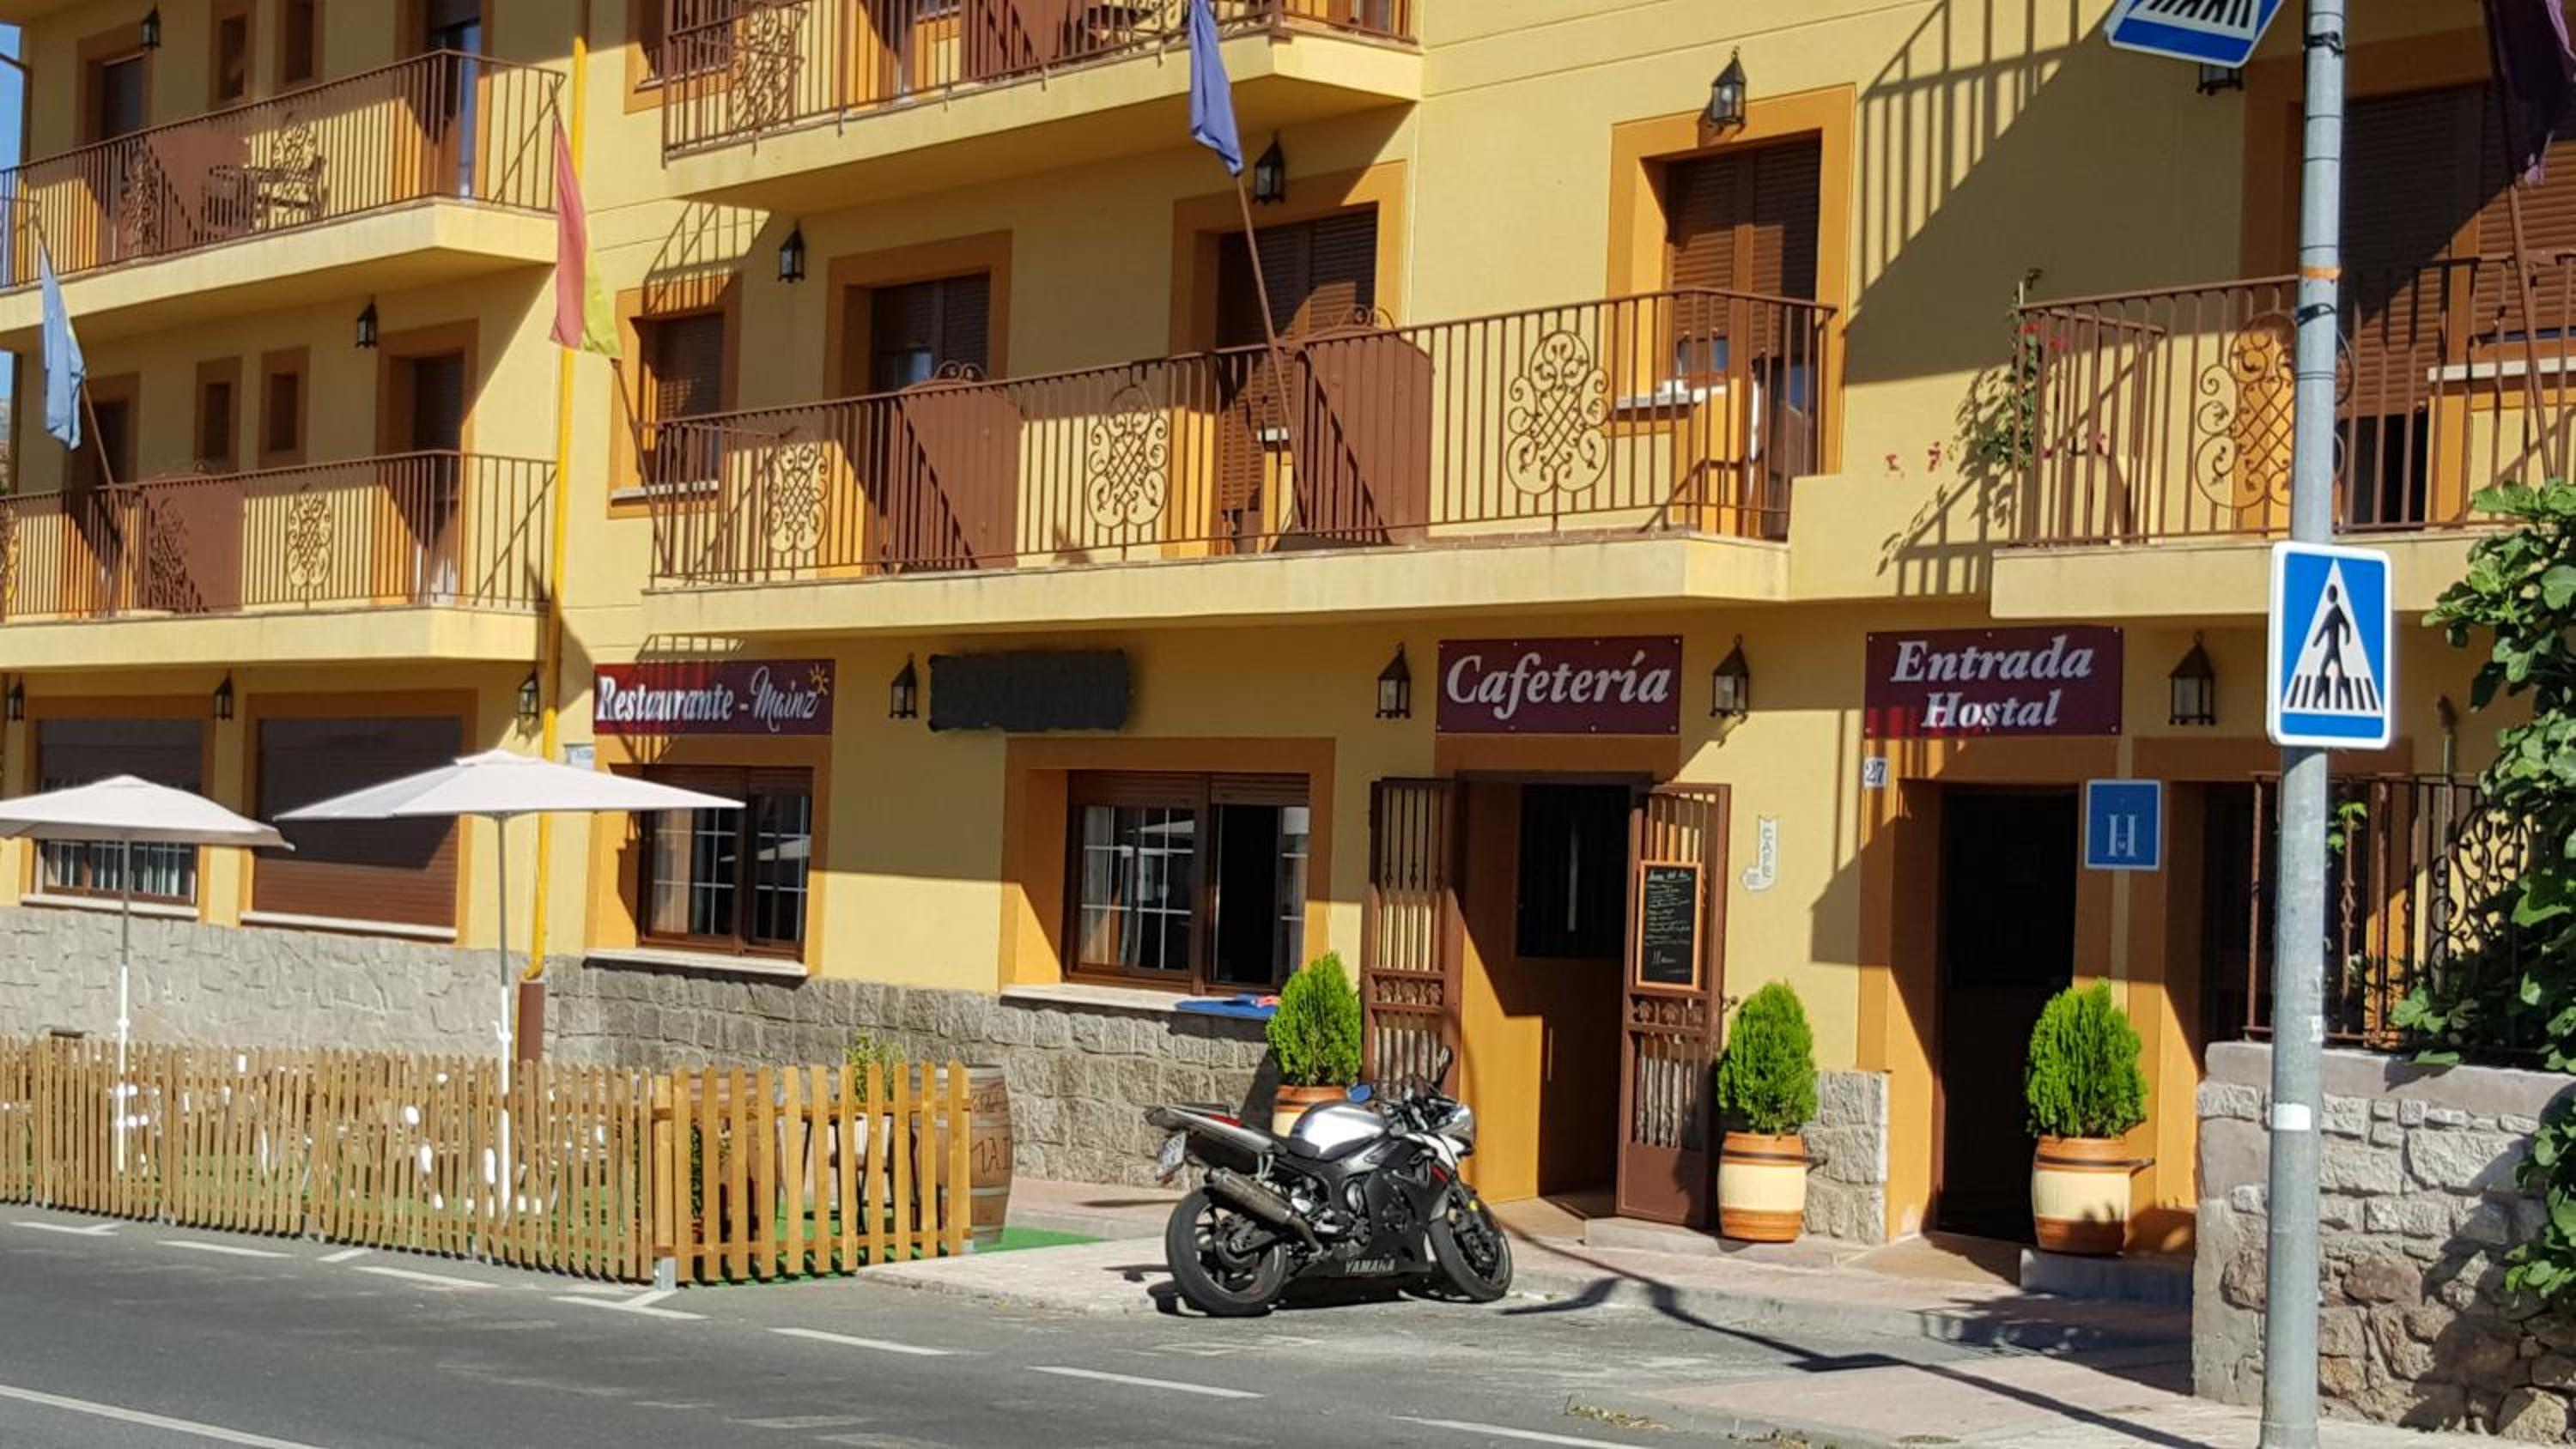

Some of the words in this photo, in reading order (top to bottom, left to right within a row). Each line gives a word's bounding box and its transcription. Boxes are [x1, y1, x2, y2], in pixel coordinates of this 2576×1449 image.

[1890, 634, 2093, 682] Entrada
[596, 676, 733, 721] Restaurante
[1447, 650, 1671, 719] Cafetería
[1922, 689, 2061, 728] Hostal
[1866, 761, 1886, 783] 27
[1345, 1258, 1395, 1273] YAMAHA
